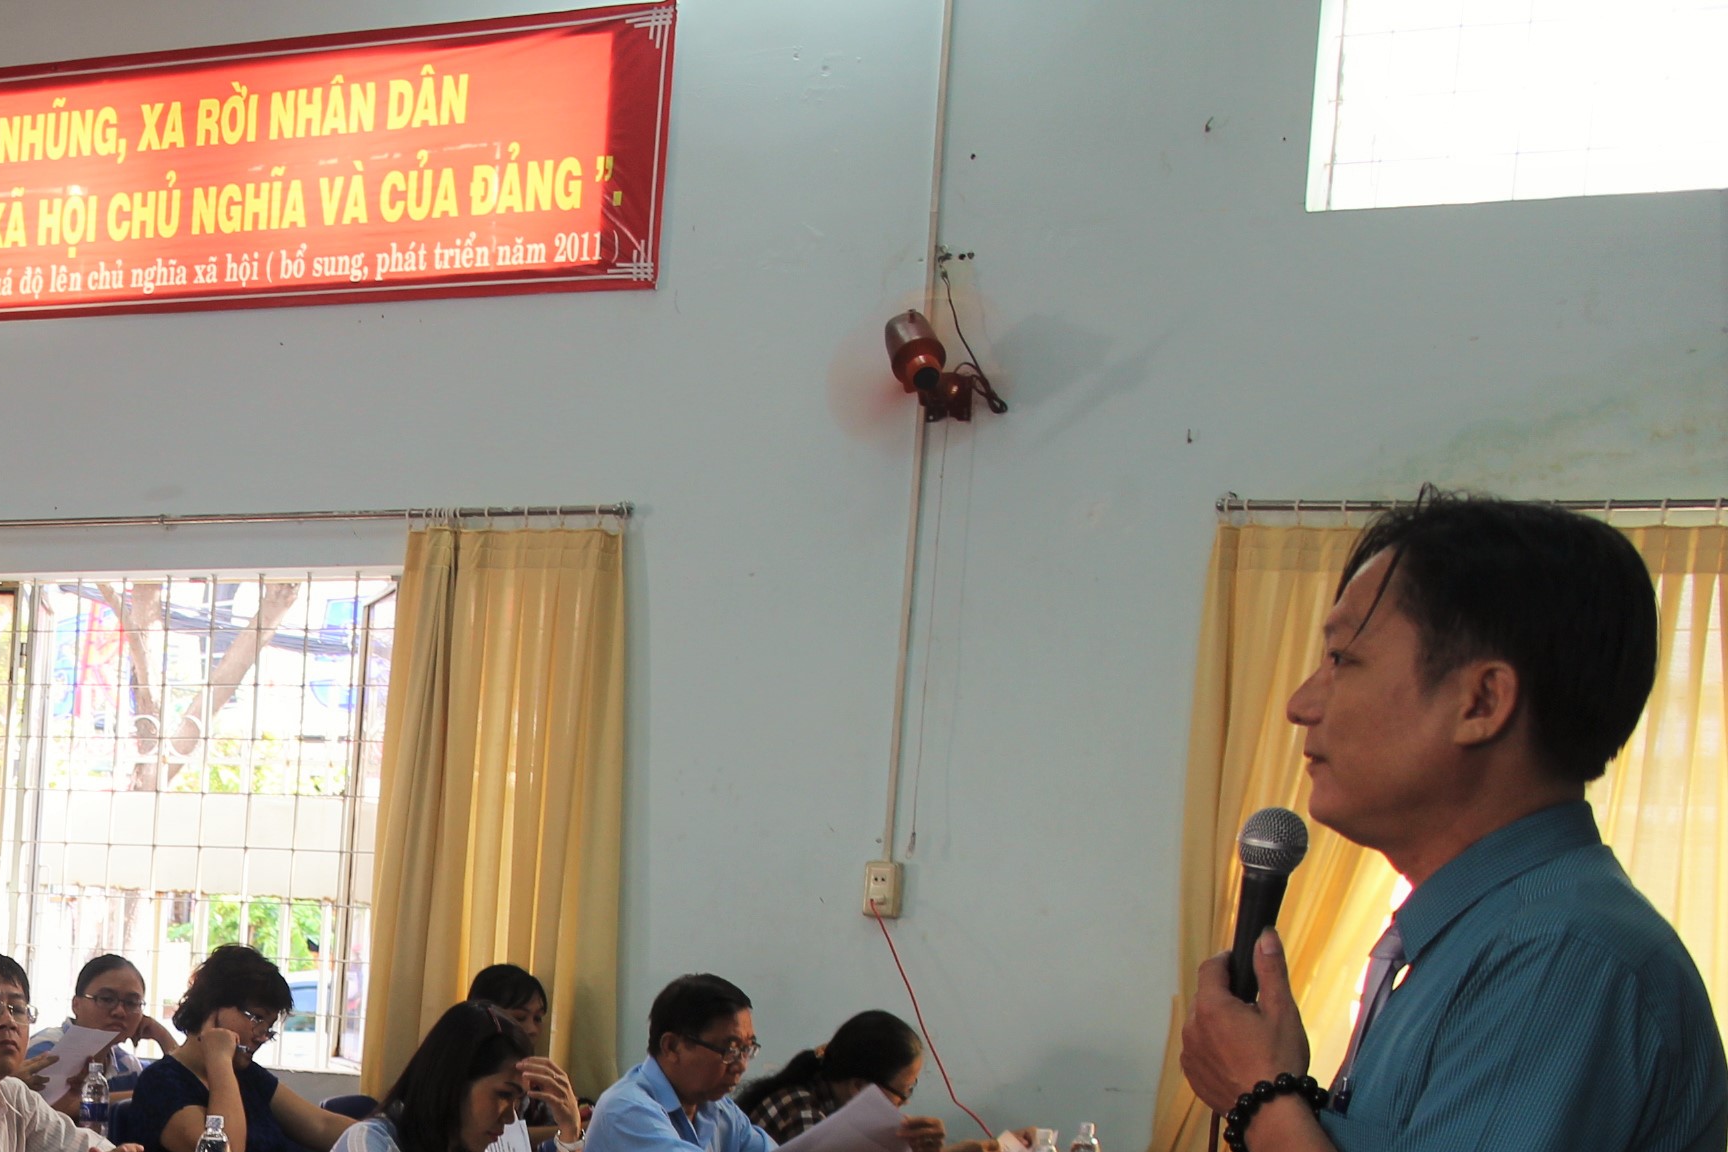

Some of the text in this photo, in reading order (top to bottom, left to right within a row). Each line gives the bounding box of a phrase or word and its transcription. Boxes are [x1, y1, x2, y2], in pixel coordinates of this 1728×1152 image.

[138, 101, 185, 152] XA
[196, 81, 259, 147] RỜI
[269, 74, 376, 141] NHÂN
[387, 64, 469, 131] DÂN
[37, 185, 97, 259] HỘI
[107, 171, 180, 241] CHỦ
[191, 166, 307, 235] NGHĨA
[319, 160, 368, 226] VÀ
[379, 150, 459, 223] CỦA
[469, 141, 582, 216] ĐẢNG
[19, 265, 43, 298] độ
[49, 265, 82, 292] lên
[87, 260, 123, 290] chủ
[130, 255, 187, 295] nghĩa
[194, 255, 218, 283] xã
[225, 252, 259, 288] hội
[375, 242, 428, 281] phát
[433, 232, 490, 269] triển
[496, 236, 546, 268] năm
